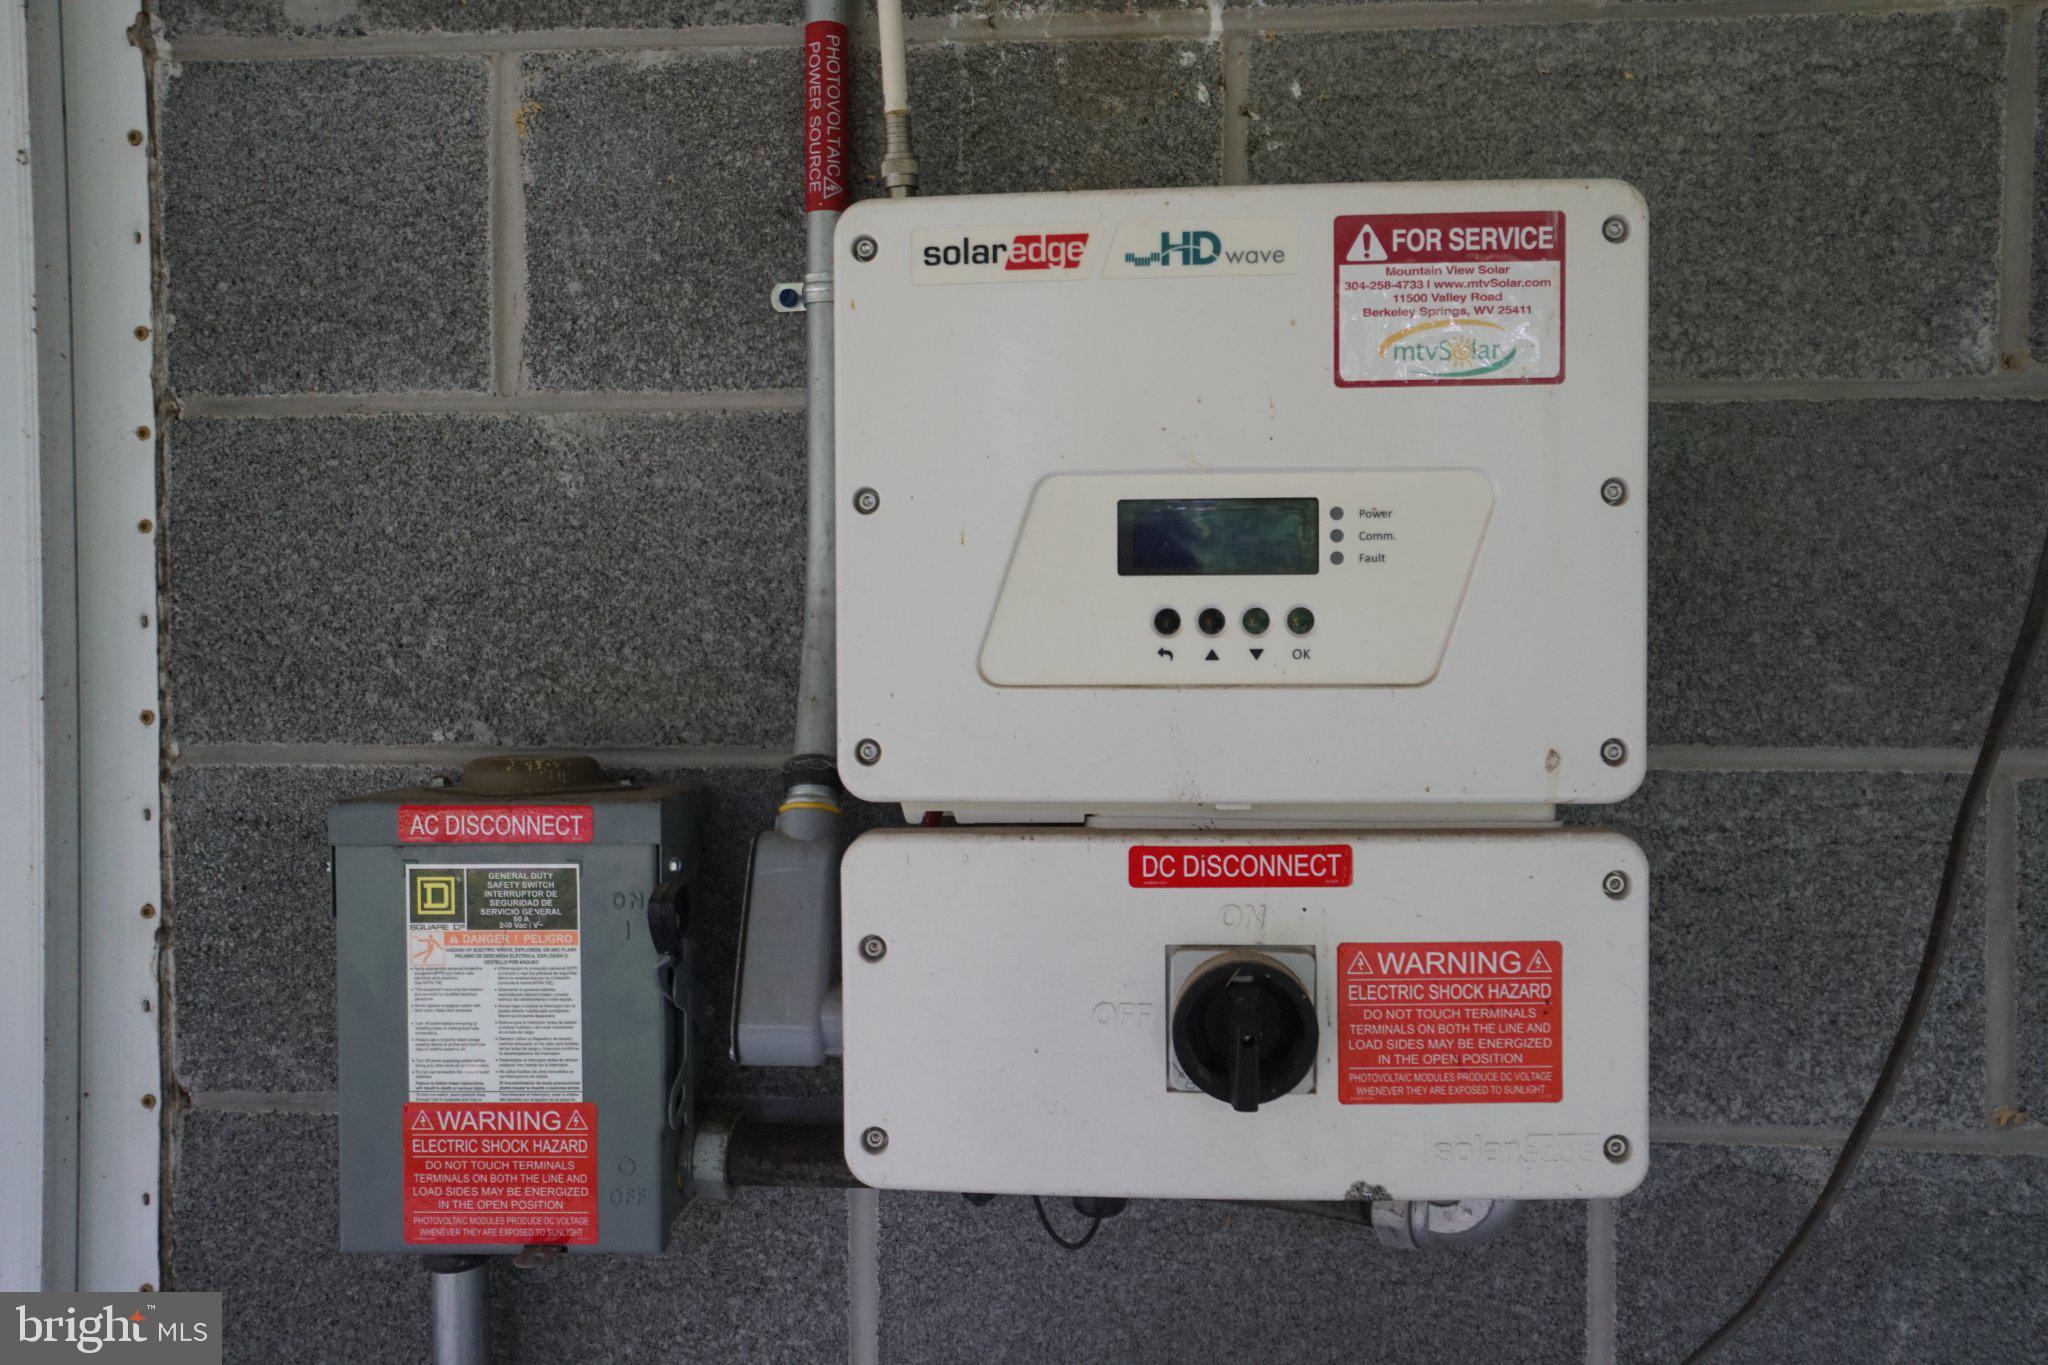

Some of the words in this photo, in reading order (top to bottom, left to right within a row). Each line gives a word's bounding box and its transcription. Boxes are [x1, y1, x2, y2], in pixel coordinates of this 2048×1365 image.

[809, 42, 821, 111] POWER
[826, 35, 840, 177] PHOTOVOLTAIC
[809, 117, 821, 193] SOURCE
[1393, 229, 1442, 252] FOR
[1449, 226, 1553, 250] SERVICE
[924, 233, 1085, 269] solaredge
[1162, 231, 1221, 266] HD
[1225, 249, 1284, 263] wave
[1386, 266, 1442, 276] Mountain
[1447, 266, 1475, 275] View
[1478, 265, 1510, 274] Solar
[1345, 280, 1423, 291] 304-258-4733
[1434, 278, 1551, 289] www.mtvSolar.com
[1393, 294, 1427, 303] 11500
[1431, 293, 1466, 304] Valley
[1471, 292, 1503, 302] Road
[1363, 307, 1415, 319] Berkeley
[1419, 307, 1470, 318] Springs,
[1474, 307, 1493, 315] WV
[1499, 306, 1532, 314] 25411
[1394, 339, 1500, 362] mtvSolar
[1359, 509, 1392, 519] Power
[1359, 531, 1396, 541] Comm.
[1359, 553, 1385, 563] Fault
[1292, 649, 1310, 660] OK
[410, 815, 439, 835] AC
[446, 815, 583, 835] DISCONNECT
[1143, 854, 1175, 877] DC
[1184, 854, 1341, 877] DISCONNECT
[484, 890, 543, 898] INTERRUPTOR
[547, 890, 558, 898] DE
[1222, 904, 1266, 929] ON
[463, 934, 509, 944] DANGER
[524, 934, 573, 944] PELIGRO
[1377, 951, 1521, 974] WARNING
[1349, 984, 1424, 1000] ELECTRIC
[1429, 984, 1484, 999] SHOCK
[1489, 983, 1552, 999] HAZARD
[1364, 1009, 1382, 1020] DO
[1386, 1009, 1412, 1019] NOT
[1416, 1009, 1460, 1019] TOUCH
[1465, 1008, 1536, 1019] TERMINALS
[1350, 1025, 1414, 1035] TERMINALS
[1419, 1024, 1434, 1034] ON
[1438, 1024, 1470, 1034] BOTH
[1474, 1024, 1495, 1034] THE
[1499, 1023, 1524, 1033] LINE
[1528, 1023, 1551, 1033] AND
[1349, 1040, 1382, 1050] LOAD
[1387, 1039, 1424, 1050] SIDES
[1428, 1039, 1454, 1049] MAY
[1459, 1039, 1474, 1049] BE
[1478, 1038, 1552, 1048] ENERGIZED
[1379, 1054, 1390, 1064] IN
[1395, 1054, 1419, 1064] THE
[1423, 1054, 1459, 1064] OPEN
[1463, 1054, 1523, 1063] POSITION
[1350, 1073, 1412, 1083] PHOTOVOLTAIC
[1415, 1073, 1455, 1083] MODULES
[1458, 1072, 1498, 1082] PRODUCE
[1501, 1072, 1512, 1081] DC
[1515, 1072, 1552, 1081] VOLTAGE
[1357, 1086, 1404, 1096] WHENEVER
[1407, 1086, 1427, 1095] THEY
[1430, 1086, 1446, 1095] ARE
[1450, 1085, 1488, 1095] EXPOSED
[1491, 1085, 1500, 1095] TO
[1503, 1085, 1545, 1095] SUNLIGHT
[436, 1111, 561, 1130] WARNING
[412, 1139, 478, 1153] ELECTRIC
[482, 1139, 529, 1153] SHOCK
[534, 1139, 587, 1153] HAZARD
[426, 1161, 442, 1170] DO
[445, 1161, 467, 1170] NOT
[471, 1161, 509, 1170] TOUCH
[513, 1161, 575, 1170] TERMINALS
[414, 1174, 469, 1183] TERMINALS
[472, 1174, 488, 1183] ON
[491, 1174, 517, 1183] BOTH
[520, 1174, 538, 1183] THE
[543, 1174, 564, 1183] LINE
[567, 1174, 587, 1183] AND
[413, 1188, 442, 1196] LOAD
[446, 1188, 478, 1196] SIDES
[482, 1188, 504, 1196] MAY
[507, 1188, 521, 1196] BE
[525, 1188, 588, 1196] ENERGIZED
[438, 1201, 449, 1210] IN
[452, 1201, 473, 1210] THE
[477, 1201, 508, 1210] OPEN
[511, 1201, 563, 1210] POSITION
